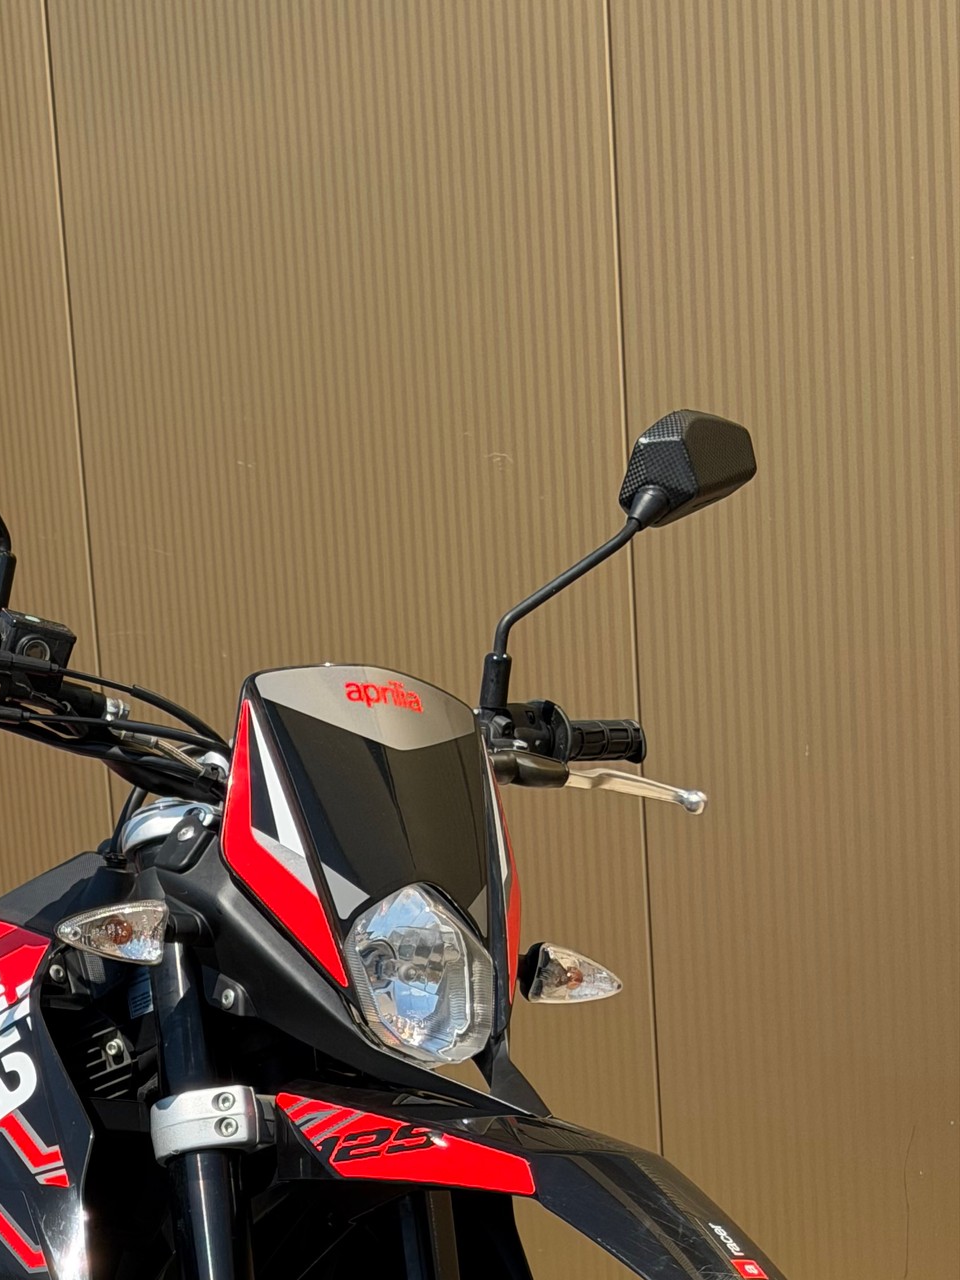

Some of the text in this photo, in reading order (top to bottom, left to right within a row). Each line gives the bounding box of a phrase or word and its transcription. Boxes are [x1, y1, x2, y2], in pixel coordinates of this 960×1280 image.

[344, 681, 423, 713] aprilia
[316, 1124, 443, 1167] 125
[708, 1222, 744, 1256] racer
